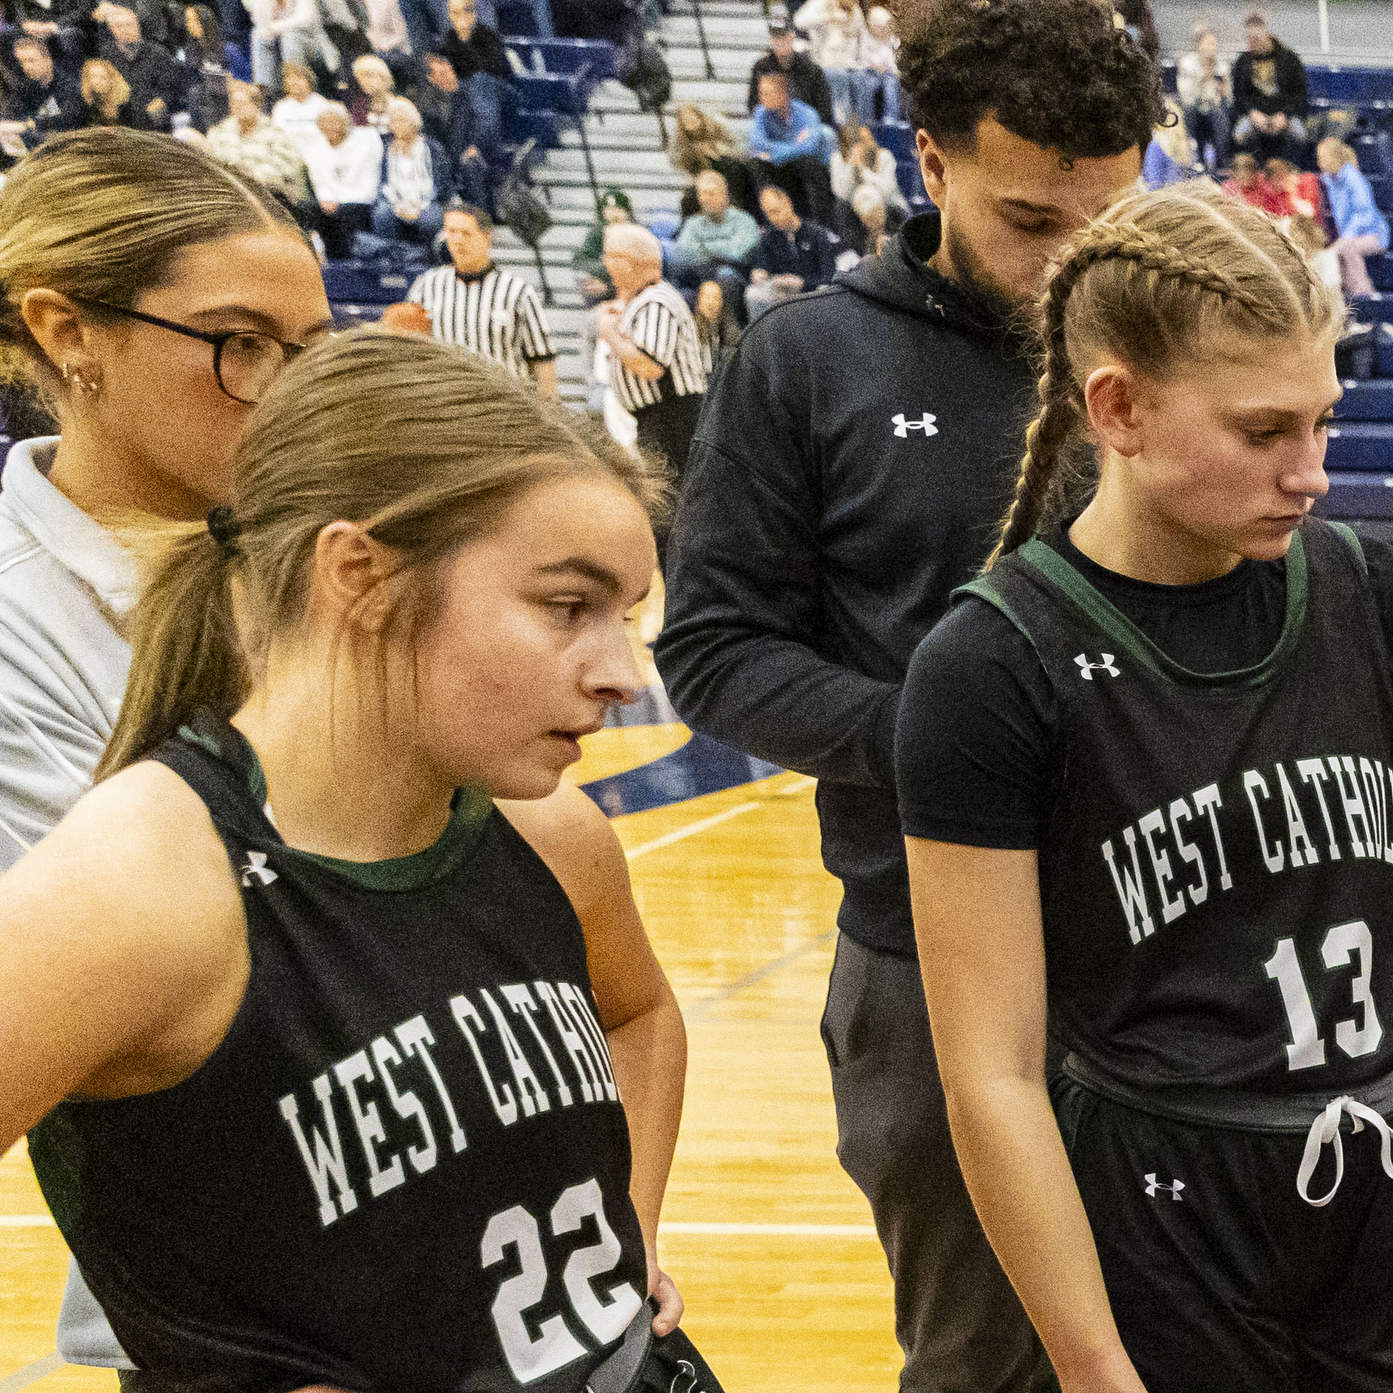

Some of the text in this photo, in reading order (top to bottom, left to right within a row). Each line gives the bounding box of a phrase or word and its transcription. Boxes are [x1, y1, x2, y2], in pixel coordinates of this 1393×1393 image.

[1101, 782, 1234, 945] WEST
[1264, 919, 1384, 1071] 13
[278, 1013, 470, 1227] WEST
[479, 1176, 645, 1385] 22
